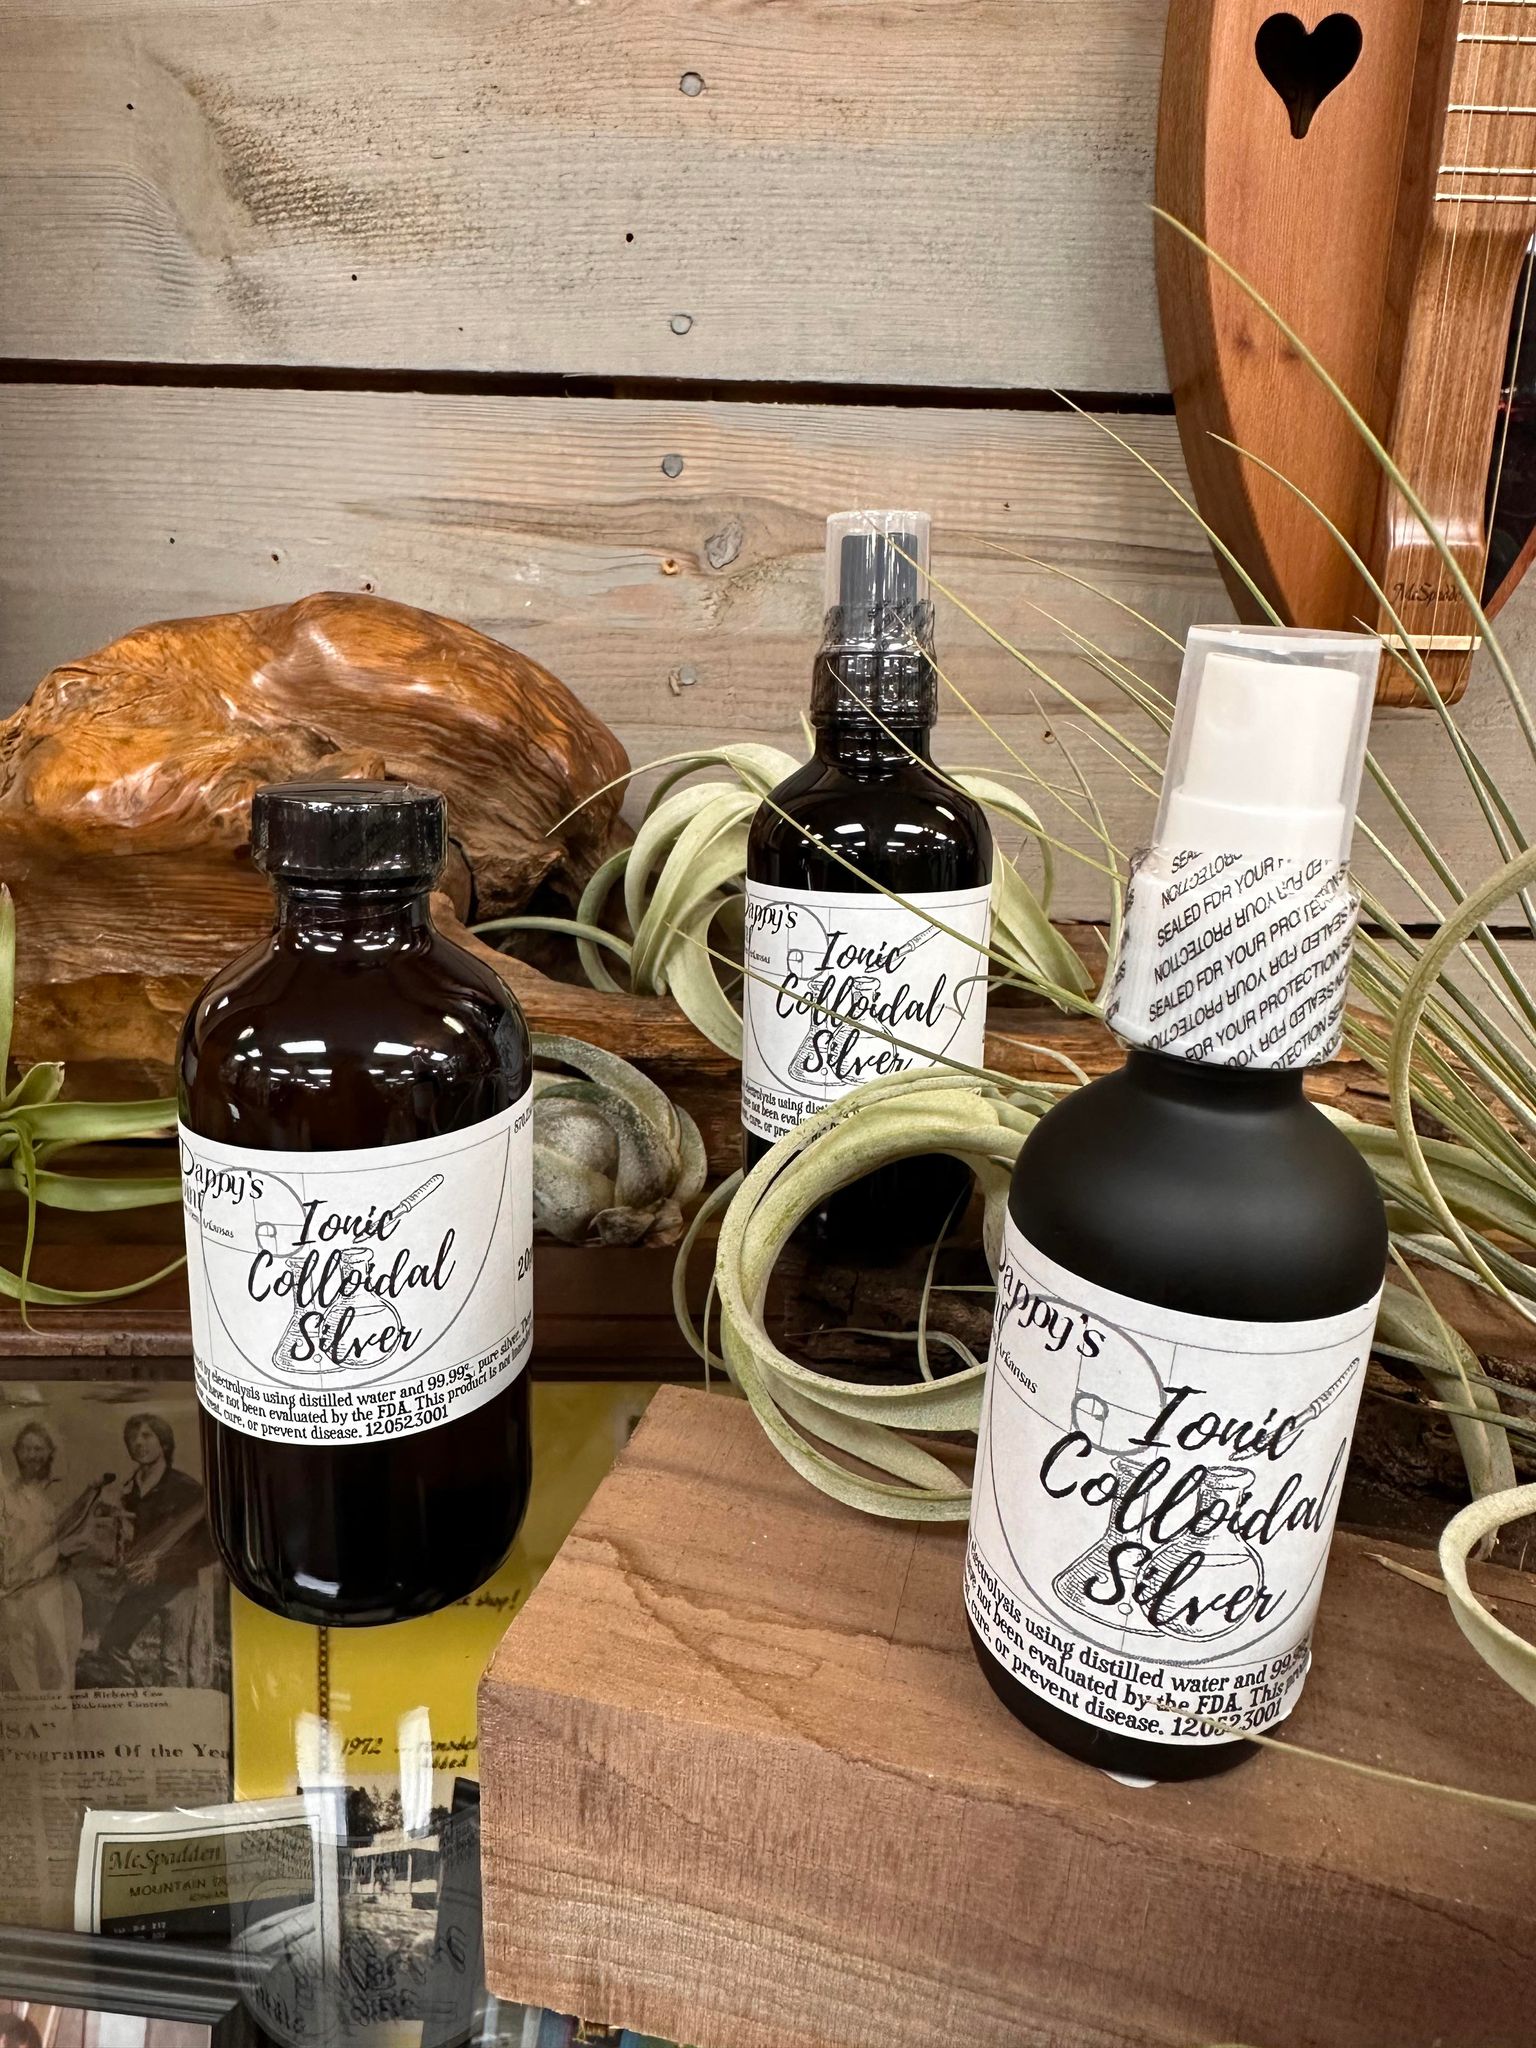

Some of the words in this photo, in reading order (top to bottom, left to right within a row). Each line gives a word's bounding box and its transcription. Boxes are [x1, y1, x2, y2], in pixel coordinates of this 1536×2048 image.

[746, 895, 798, 934] appy's
[1157, 903, 1201, 948] SEALED
[1234, 857, 1274, 894] YOUR
[1235, 892, 1277, 928] YOUR
[814, 931, 906, 973] Ionic
[1149, 979, 1194, 1023] SEALED
[1196, 959, 1224, 991] FOR
[1225, 931, 1267, 970] YOUR
[1154, 917, 1233, 985] PROTECTION
[776, 973, 947, 1028] Colloidal
[1215, 1009, 1257, 1047] YOUR
[1259, 948, 1340, 1020] PROTECTION
[1225, 967, 1267, 1006] YOUR
[1289, 981, 1334, 1029] SEALED
[803, 1029, 912, 1080] Silver
[1224, 1043, 1259, 1067] YOU
[1271, 1016, 1327, 1068] OTECTION
[778, 1098, 803, 1114] using
[292, 1199, 401, 1246] Ionic
[248, 1228, 456, 1308] Colloidal
[1000, 1245, 1107, 1358] appy's
[290, 1306, 423, 1366] Silver
[211, 1369, 260, 1401] electrolysis
[262, 1391, 295, 1408] using
[299, 1392, 354, 1407] distilled
[357, 1391, 397, 1406] water
[399, 1380, 425, 1399] and
[478, 1349, 499, 1374] pure
[226, 1395, 240, 1411] not
[242, 1397, 266, 1418] been
[269, 1408, 328, 1424] evaluated
[332, 1409, 349, 1426] by
[352, 1408, 373, 1423] the
[377, 1401, 412, 1420] FDA.
[415, 1392, 445, 1411] This
[448, 1375, 487, 1405] product
[489, 1365, 498, 1380] is
[224, 1409, 245, 1428] cure,
[247, 1420, 259, 1432] or
[261, 1422, 308, 1439] prevent
[311, 1426, 362, 1439] disease.
[366, 1404, 449, 1437] 120523001
[1128, 1385, 1304, 1461] Ionic
[1039, 1431, 1347, 1545] Colloidal
[1084, 1540, 1287, 1626] Silver
[971, 1600, 992, 1643] cure,
[995, 1636, 1011, 1660] or
[1011, 1653, 1080, 1708] prevent
[1085, 1696, 1165, 1735] disease.
[977, 1584, 992, 1616] not
[993, 1601, 1025, 1650] been
[1029, 1645, 1118, 1701] evaluated
[1122, 1683, 1151, 1712] by
[1156, 1692, 1190, 1712] the
[1194, 1692, 1242, 1715] FDA.
[1249, 1681, 1284, 1708] This
[1025, 1617, 1075, 1660] using
[1079, 1647, 1165, 1689] distilled
[1171, 1675, 1230, 1693] water
[1233, 1663, 1267, 1690] and
[114, 1743, 141, 1758] Of
[151, 1743, 184, 1758] the
[342, 1736, 383, 1755] 1972
[108, 1842, 221, 1875] McSpadden
[129, 1879, 206, 1897] MOUNTAIN
